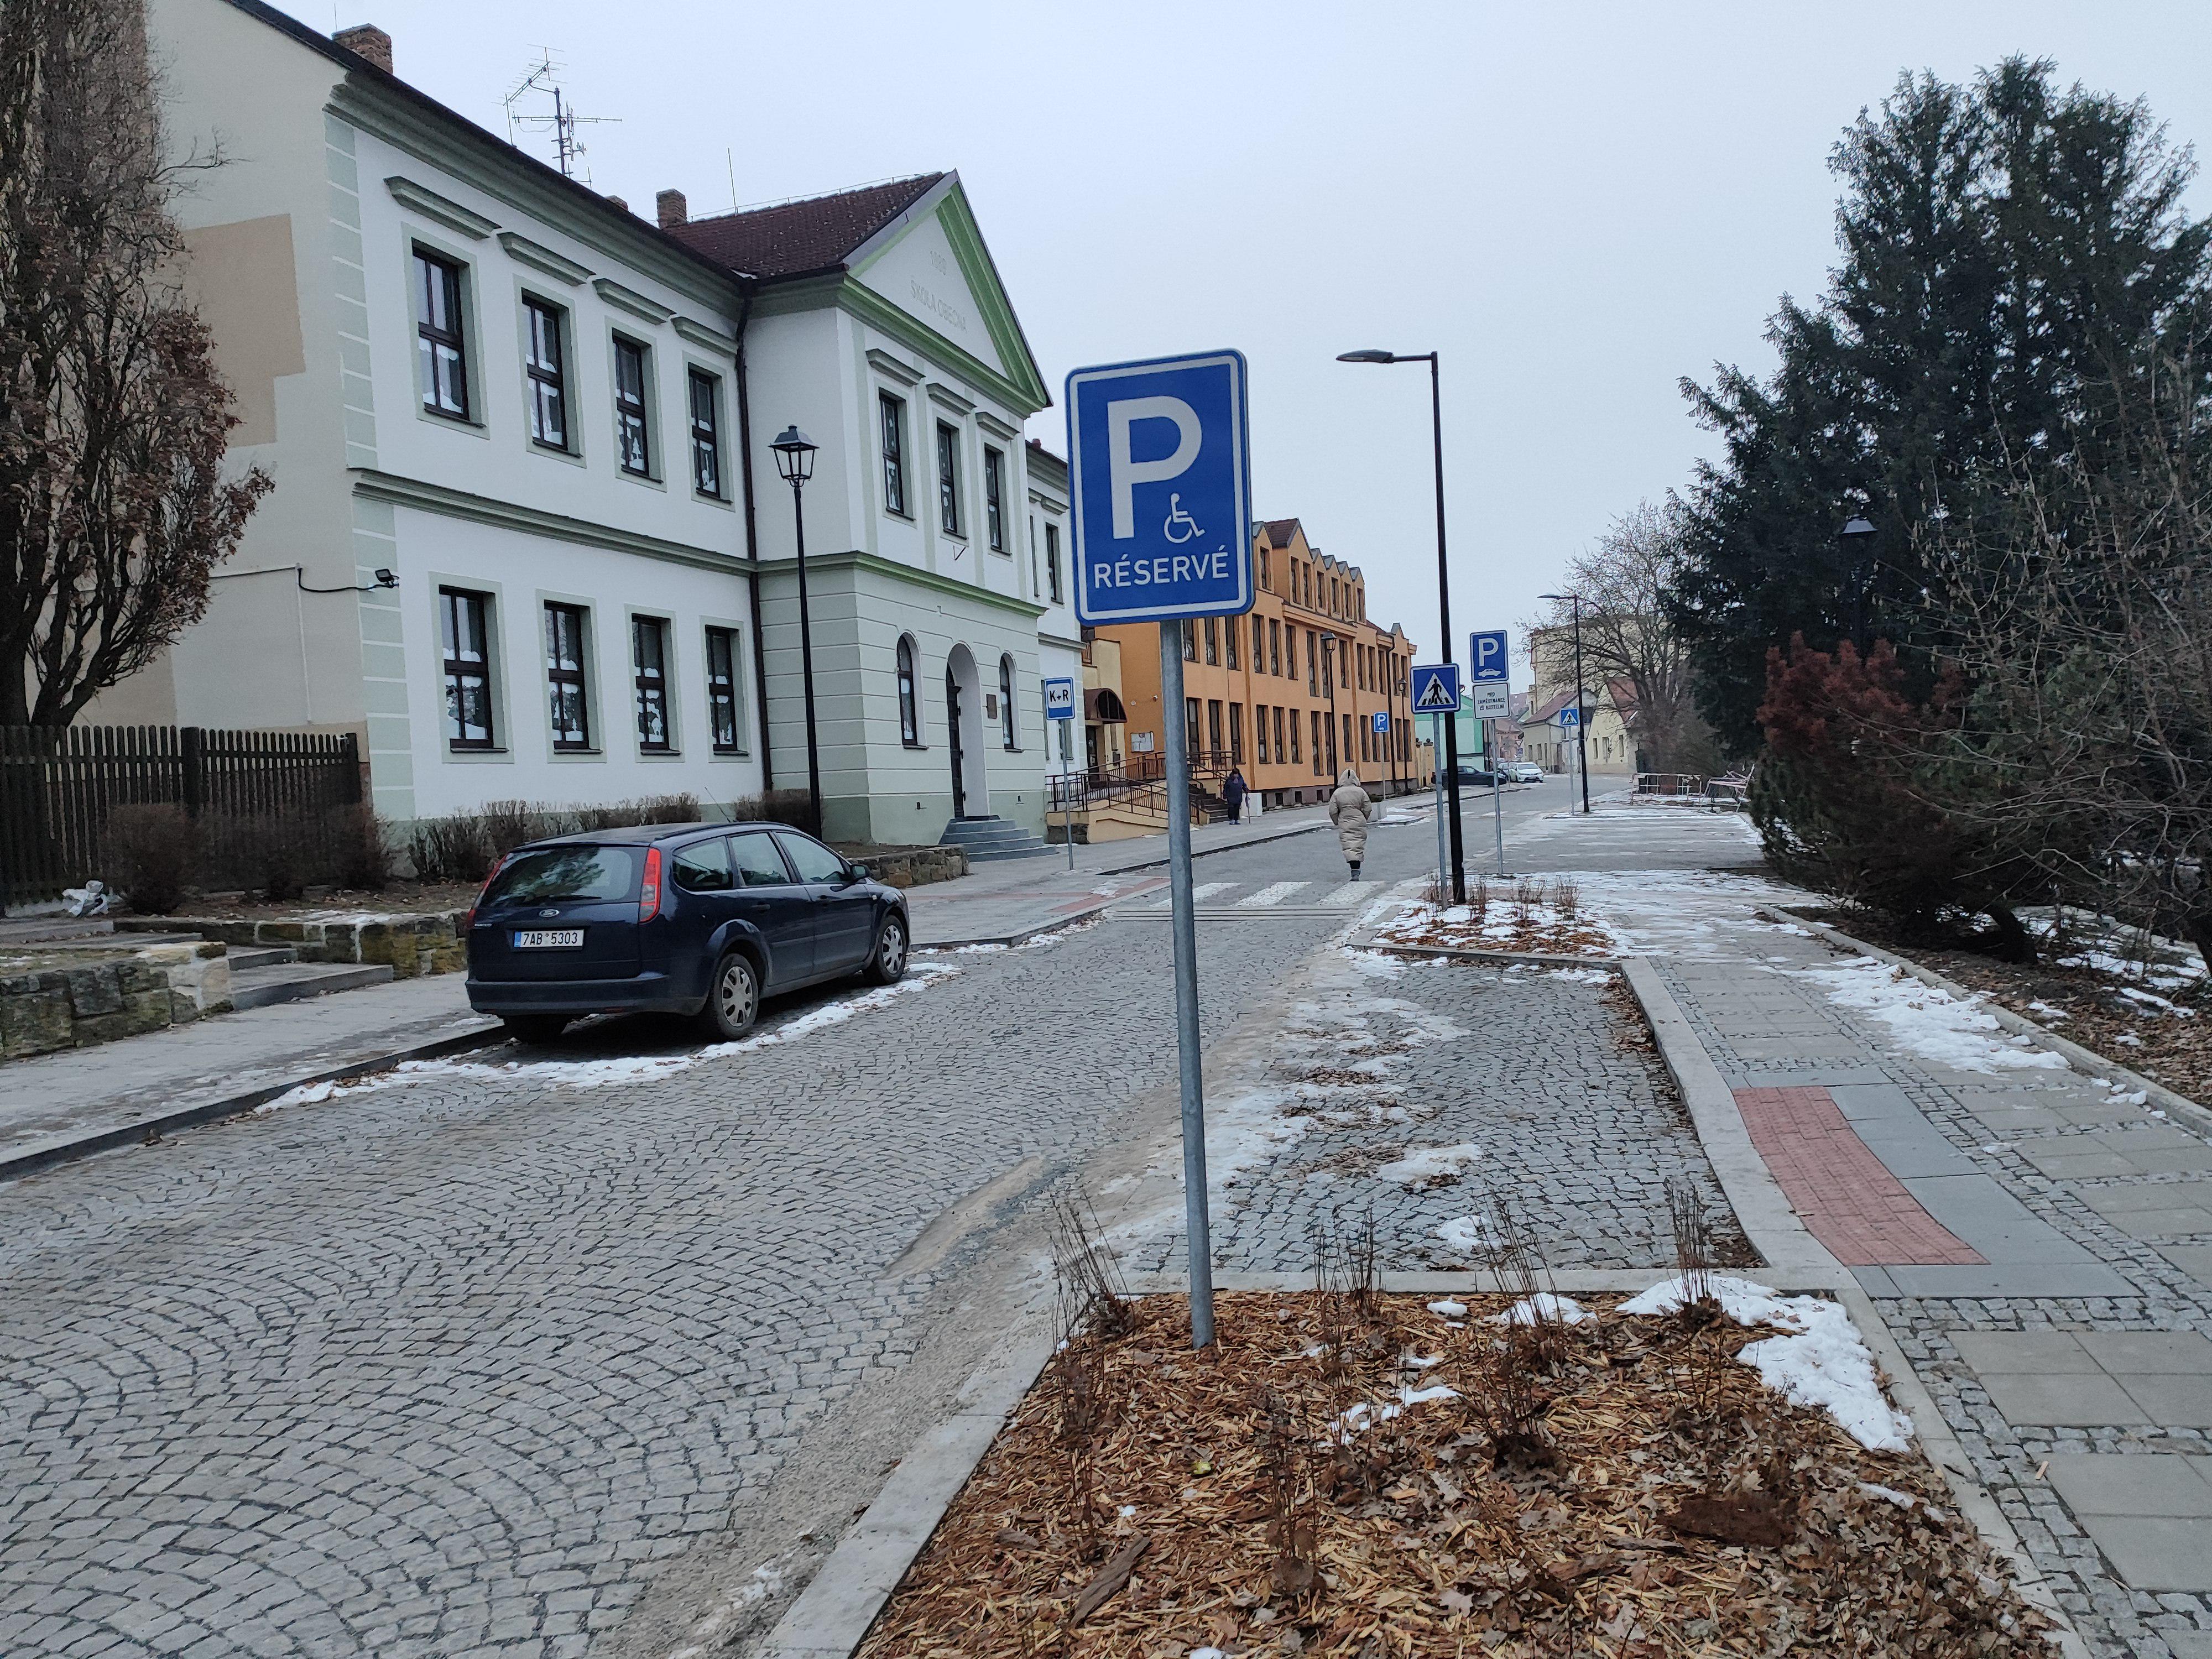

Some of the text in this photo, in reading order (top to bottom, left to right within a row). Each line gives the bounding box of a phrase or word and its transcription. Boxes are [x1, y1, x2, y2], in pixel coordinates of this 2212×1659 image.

[1107, 395, 1202, 540] P
[1094, 545, 1229, 589] RÉSERVÉ
[1478, 638, 1499, 667] P
[1050, 689, 1069, 702] K+R
[1377, 714, 1386, 727] P
[523, 932, 578, 946] 7AB 5303
